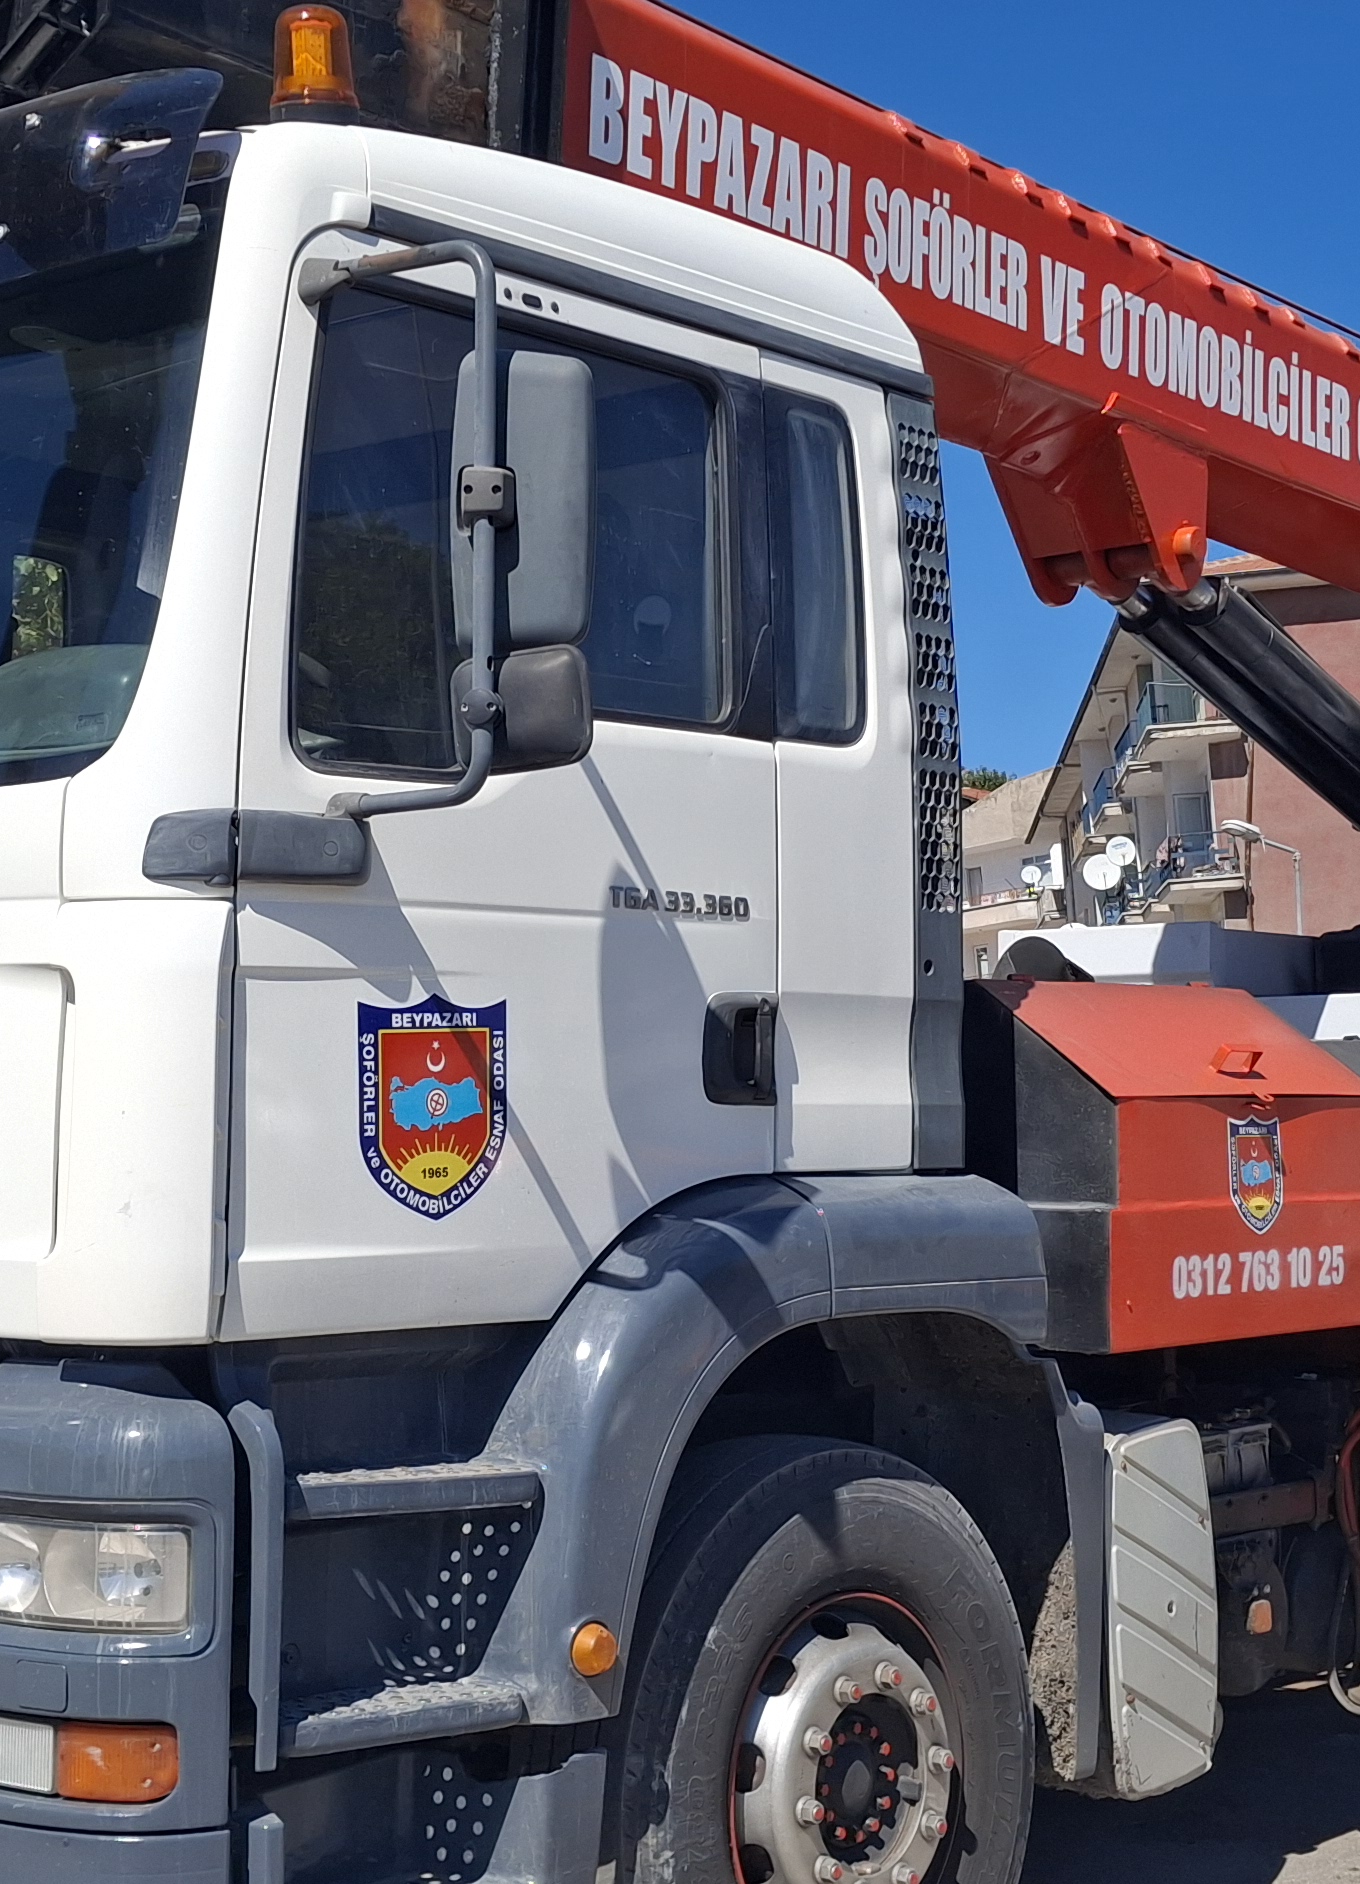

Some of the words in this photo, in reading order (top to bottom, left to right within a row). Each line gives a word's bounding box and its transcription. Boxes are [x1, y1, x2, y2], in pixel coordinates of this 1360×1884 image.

[588, 53, 851, 260] BEYPAZARI
[863, 176, 1029, 332] ŞOFÖRLER
[1039, 254, 1086, 356] VE
[1099, 283, 1351, 461] OTOMOBİLCİLER
[609, 885, 659, 911] TGA
[664, 890, 751, 918] 33.360
[391, 1012, 477, 1028] BEYPAZARI
[359, 1032, 379, 1138] ŞOFÖRLER
[492, 1030, 504, 1091] ODASI
[484, 1100, 505, 1161] ESNAF
[420, 1166, 449, 1180] 1965
[1172, 1252, 1232, 1299] 0312
[1239, 1248, 1280, 1293] 763
[1287, 1247, 1312, 1288] 10
[1318, 1245, 1345, 1286] 25
